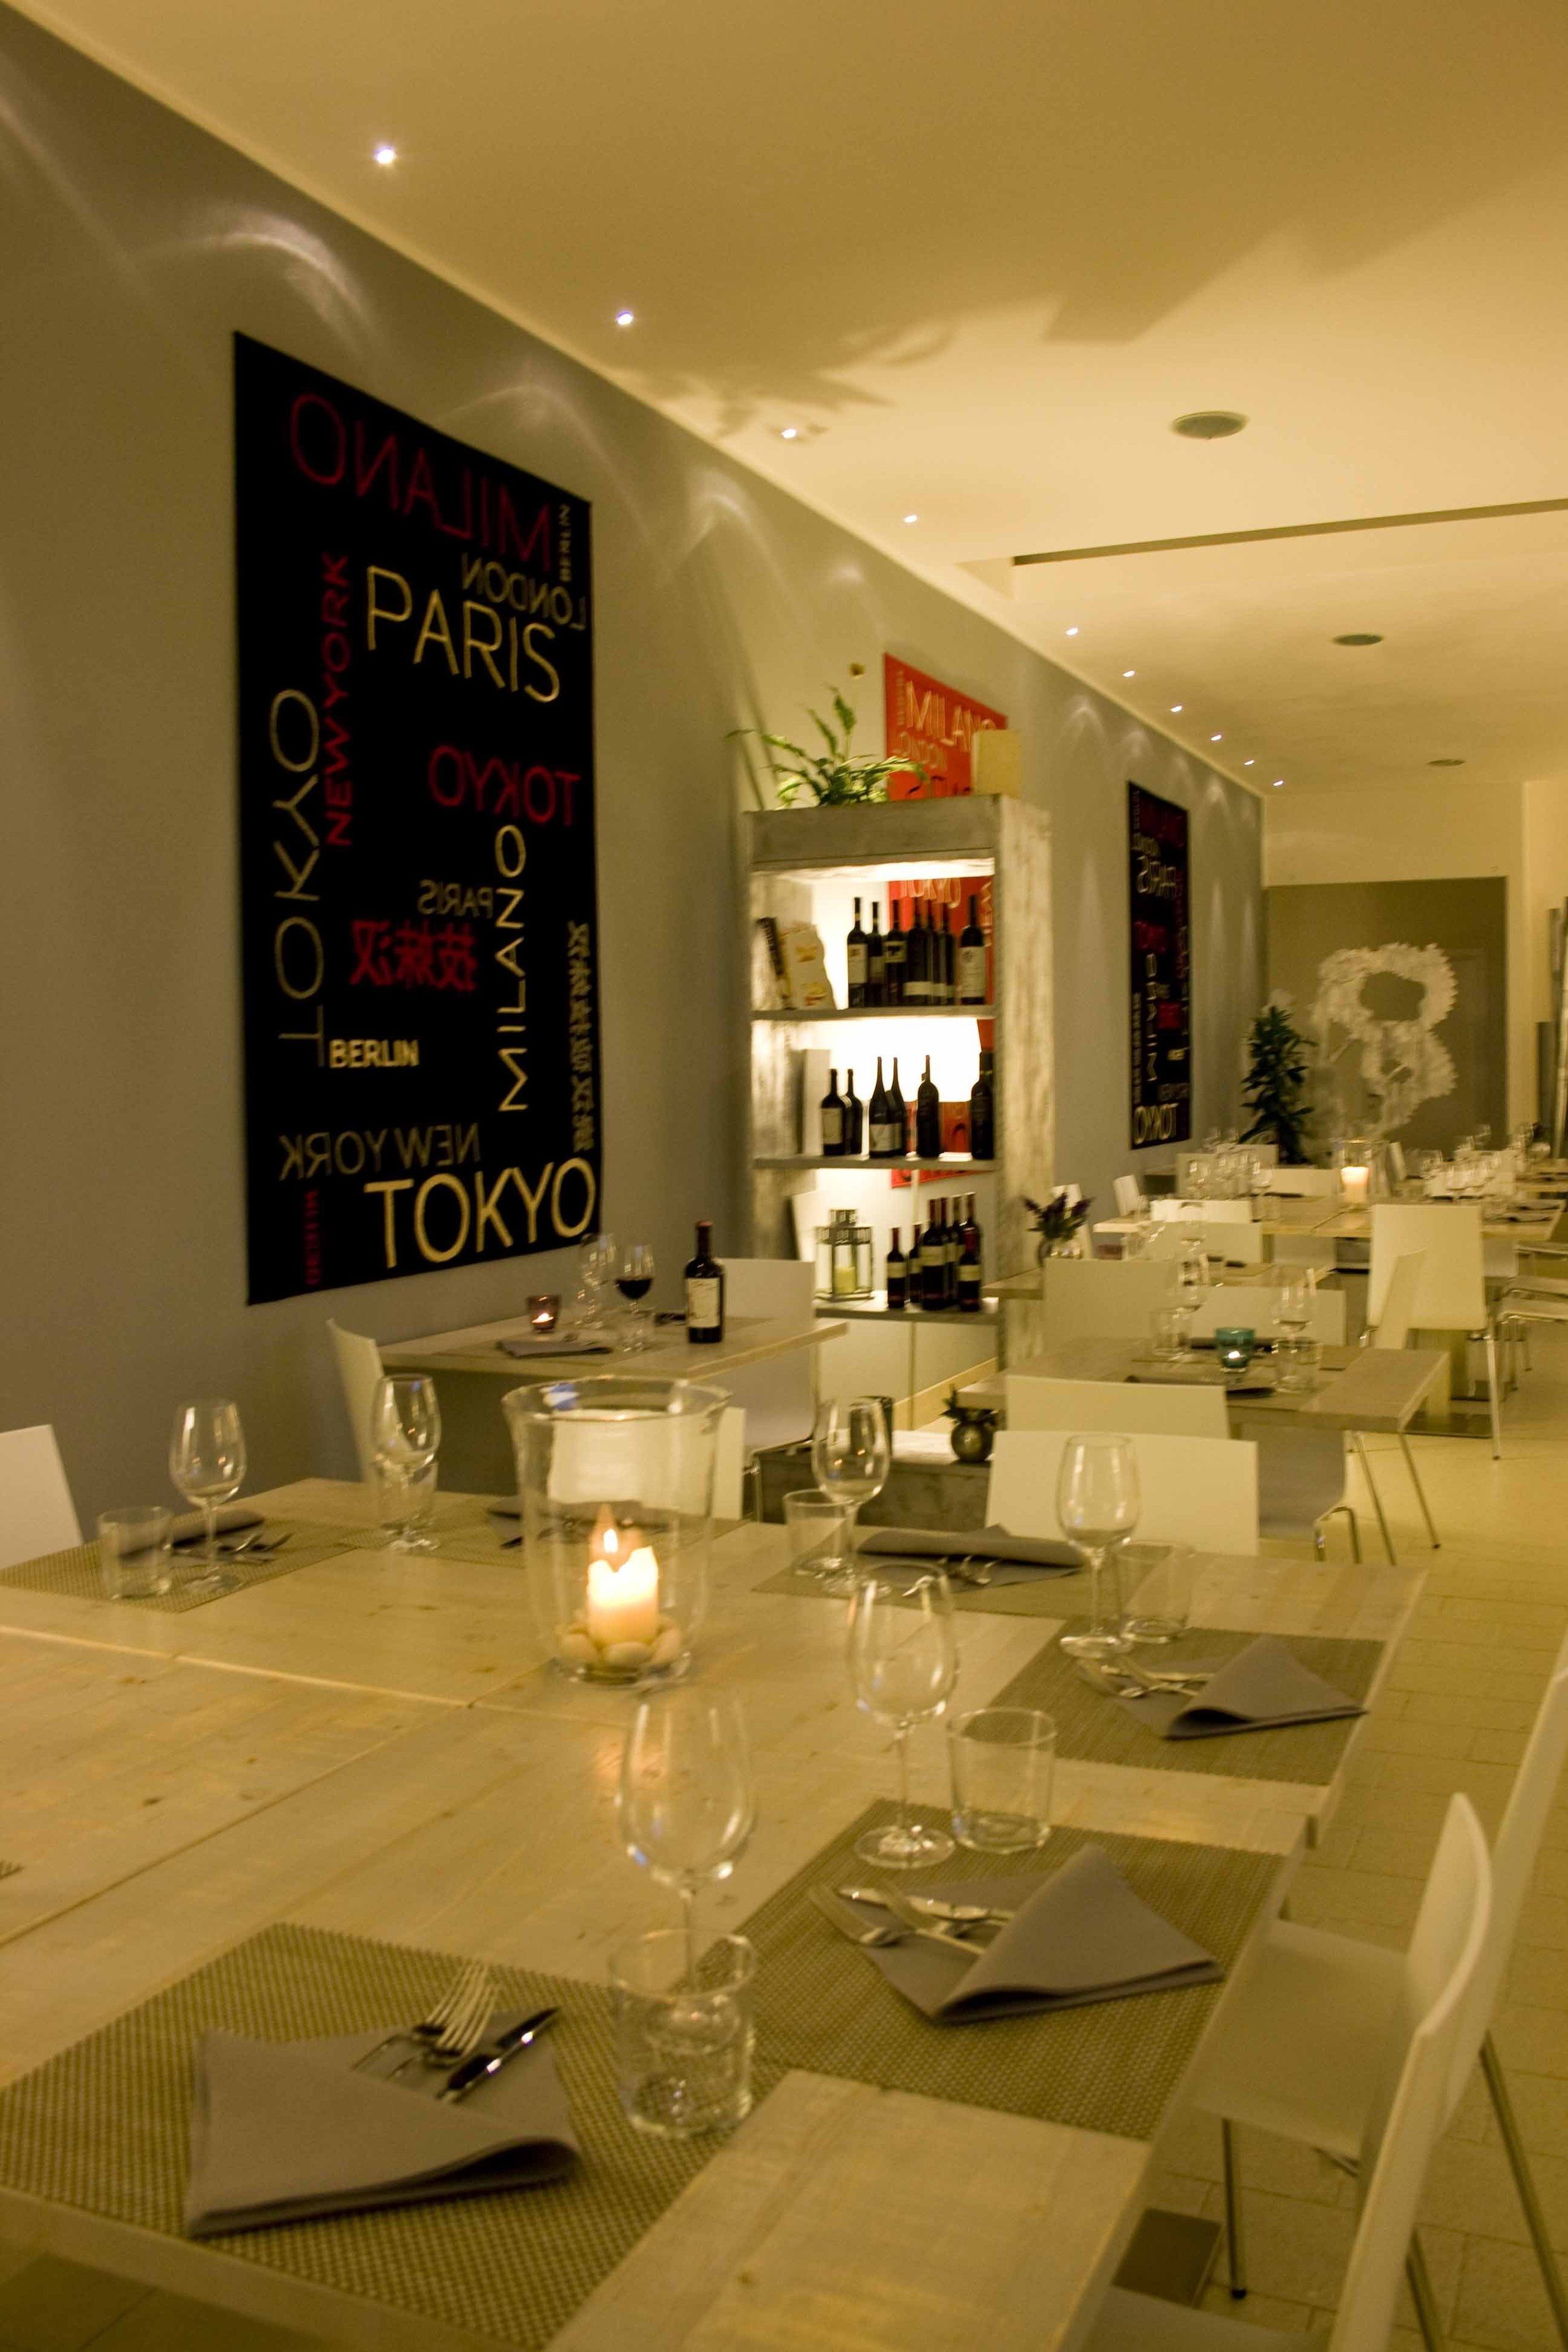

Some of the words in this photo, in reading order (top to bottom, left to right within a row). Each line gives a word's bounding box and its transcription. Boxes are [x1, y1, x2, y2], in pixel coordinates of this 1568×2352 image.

[322, 552, 350, 709] YORK
[368, 564, 560, 703] PARIS
[322, 714, 353, 848] NEW
[494, 824, 528, 1112] MILANO
[329, 1039, 420, 1068] BERLIN
[364, 1156, 597, 1269] TOKYO
